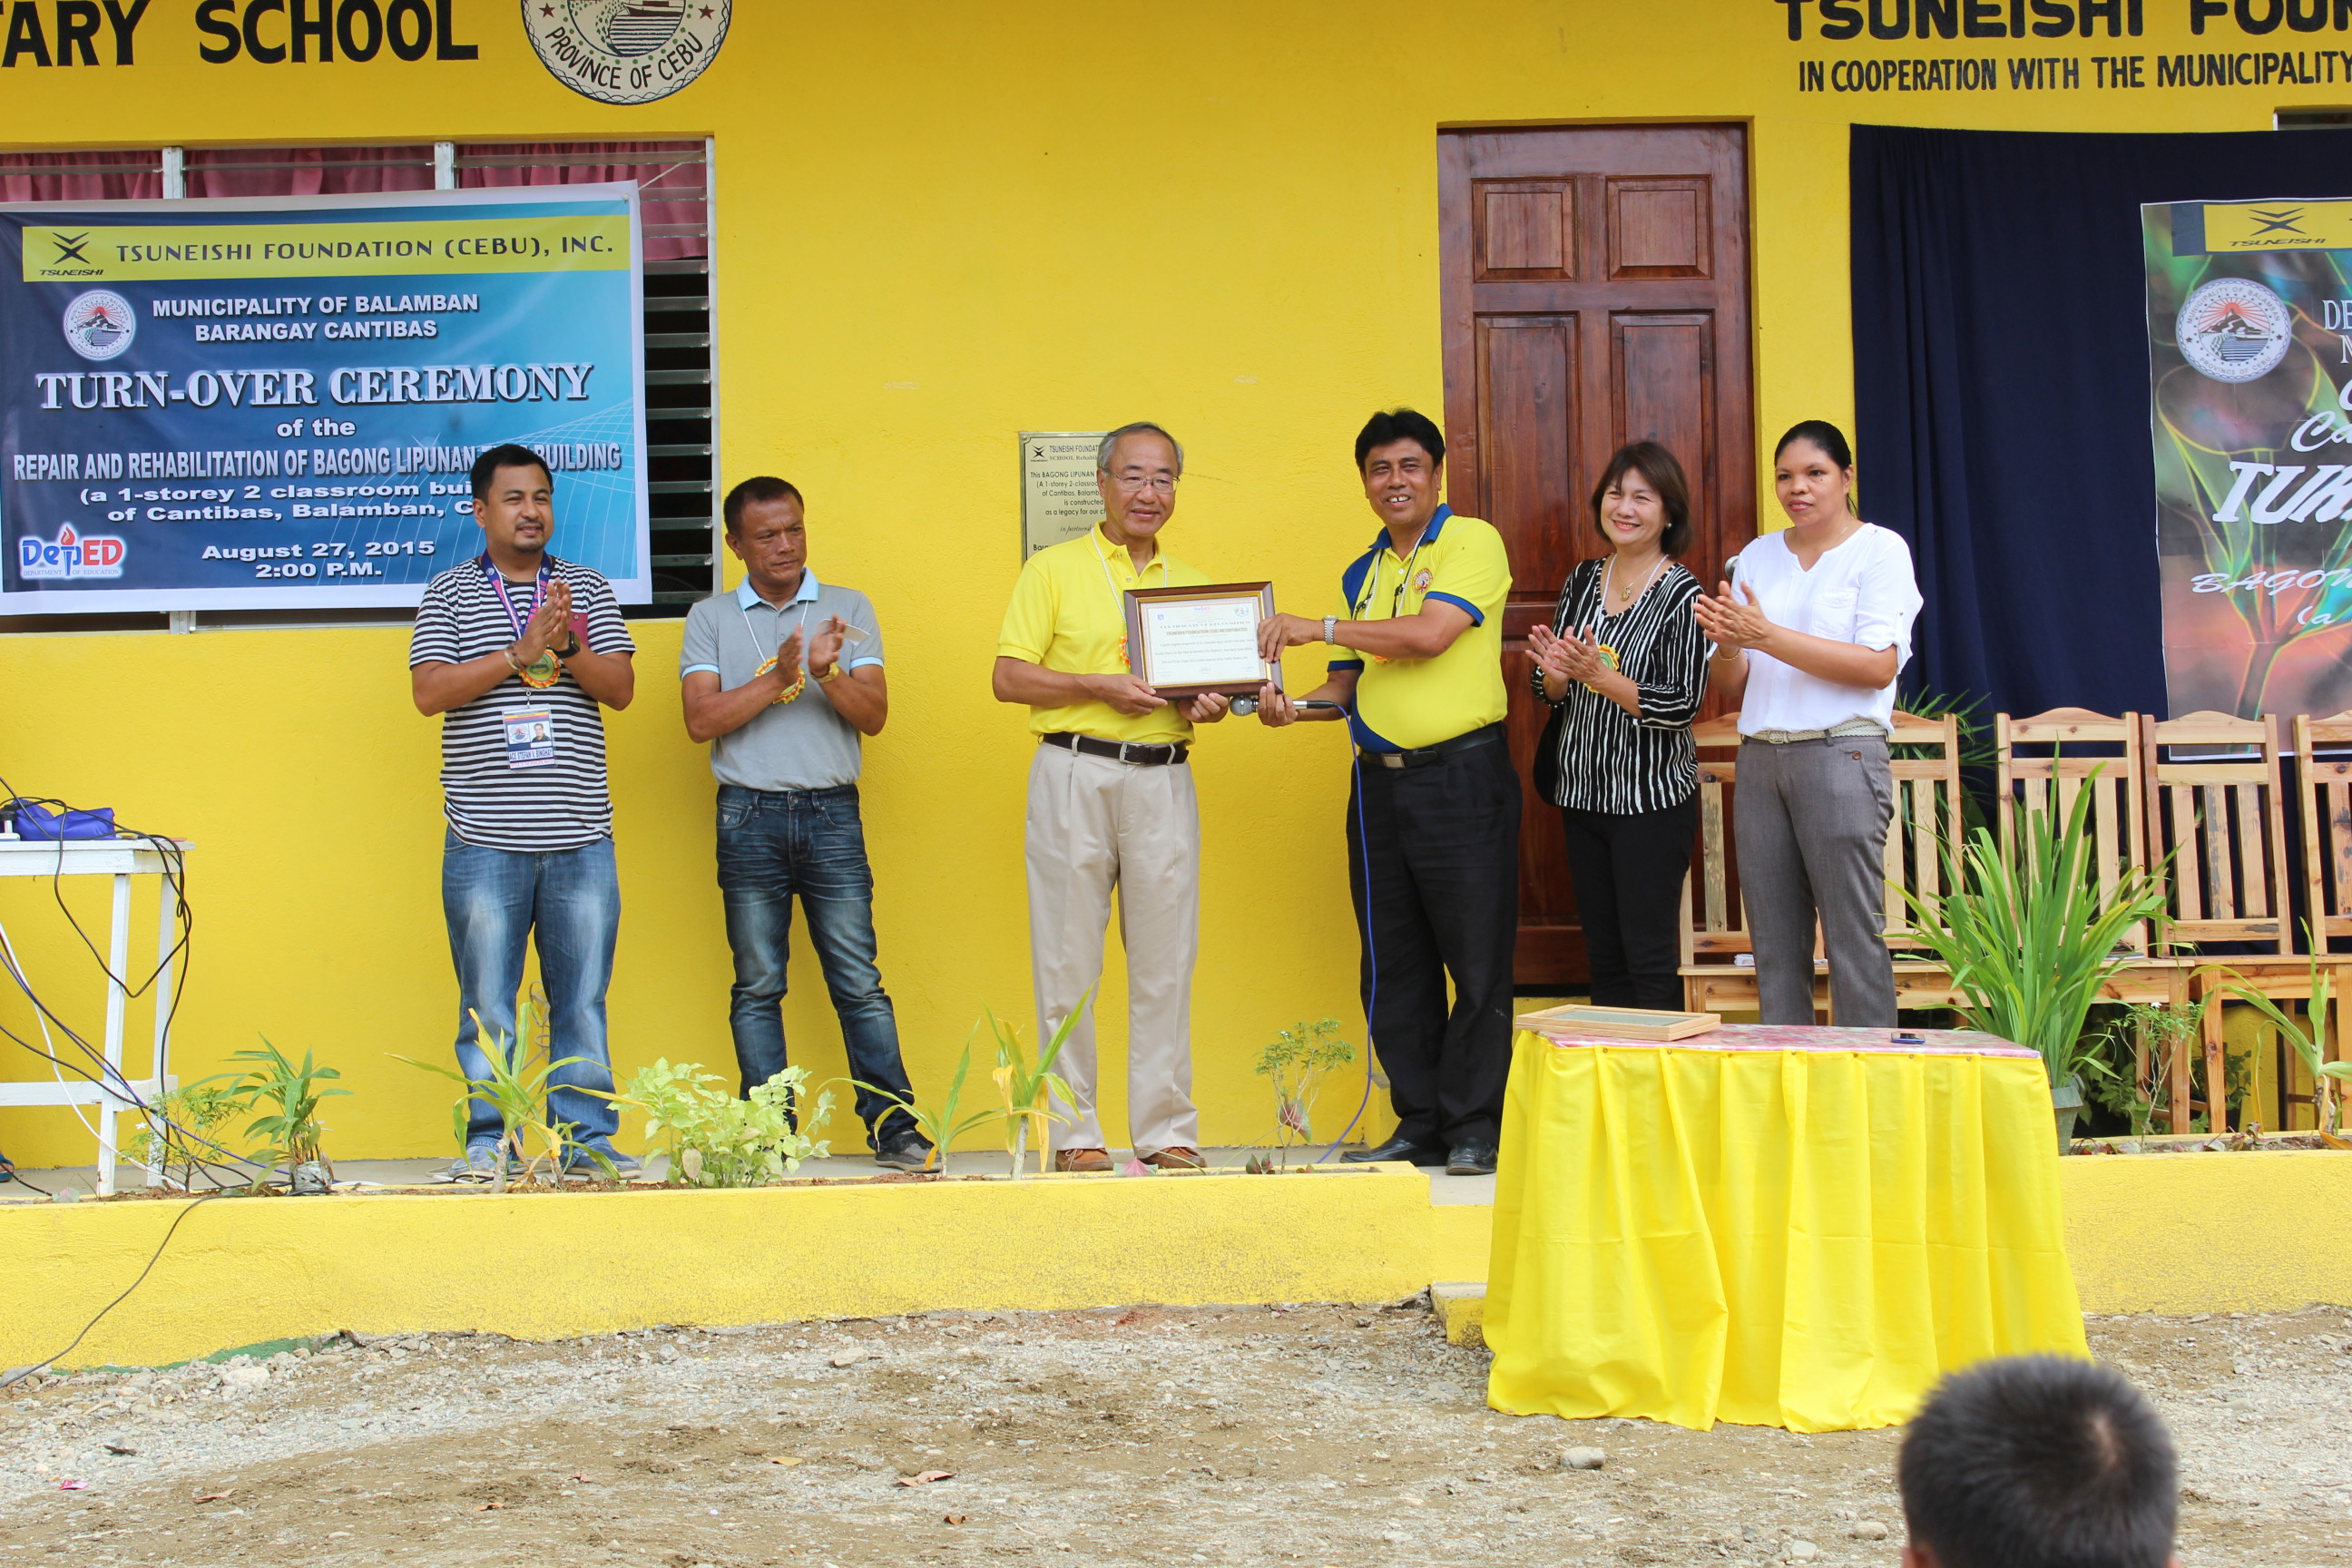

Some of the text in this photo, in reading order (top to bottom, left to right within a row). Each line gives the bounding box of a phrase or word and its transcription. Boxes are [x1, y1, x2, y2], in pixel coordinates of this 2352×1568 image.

[1774, 0, 2143, 41] TSUNEISHI
[0, 0, 479, 68] ARY SCHOOL
[544, 26, 703, 90] PROVINCE OF CEBU
[1799, 50, 2352, 92] IN COOPERATION WITH THE MUNICIPALITY
[116, 235, 613, 262] TSUNEISHI FOUNDATION (CEBU), INC.
[2229, 238, 2327, 247] TSUNEISHI
[152, 293, 479, 318] MUNICIPALITY OF BALAMBAN
[2187, 287, 2229, 324] MUNICIPALITY
[2248, 289, 2280, 321] BALAMBAN
[195, 319, 438, 342] BARANGAY CANTIBAS
[2200, 357, 2236, 375] PROVINCE
[2252, 357, 2271, 371] CEBU
[36, 364, 593, 409] TURN-OVER CEREMONY
[277, 417, 357, 437] of the
[1049, 445, 1074, 453] TSUNEISHI
[14, 442, 621, 480] REPAIR AND REHABILITATION OF BAGONG LIPUNAN BUILDING
[80, 488, 107, 505] (a
[118, 486, 234, 503] 1-storey
[244, 485, 261, 499] 2
[270, 484, 419, 498] classroom
[1036, 481, 1044, 489] (A
[1044, 480, 1068, 488] 1-storey
[1049, 489, 1075, 497] Cantibas,
[107, 507, 136, 522] of
[147, 505, 282, 522] Cantibas,
[292, 503, 445, 518] Balamban,
[1058, 508, 1079, 516] legacy
[1080, 507, 1088, 515] for
[23, 539, 123, 575] DepED
[201, 541, 436, 562] August 27, 2015
[255, 562, 382, 578] 2:00 P.M.
[2297, 605, 2337, 625] (a
